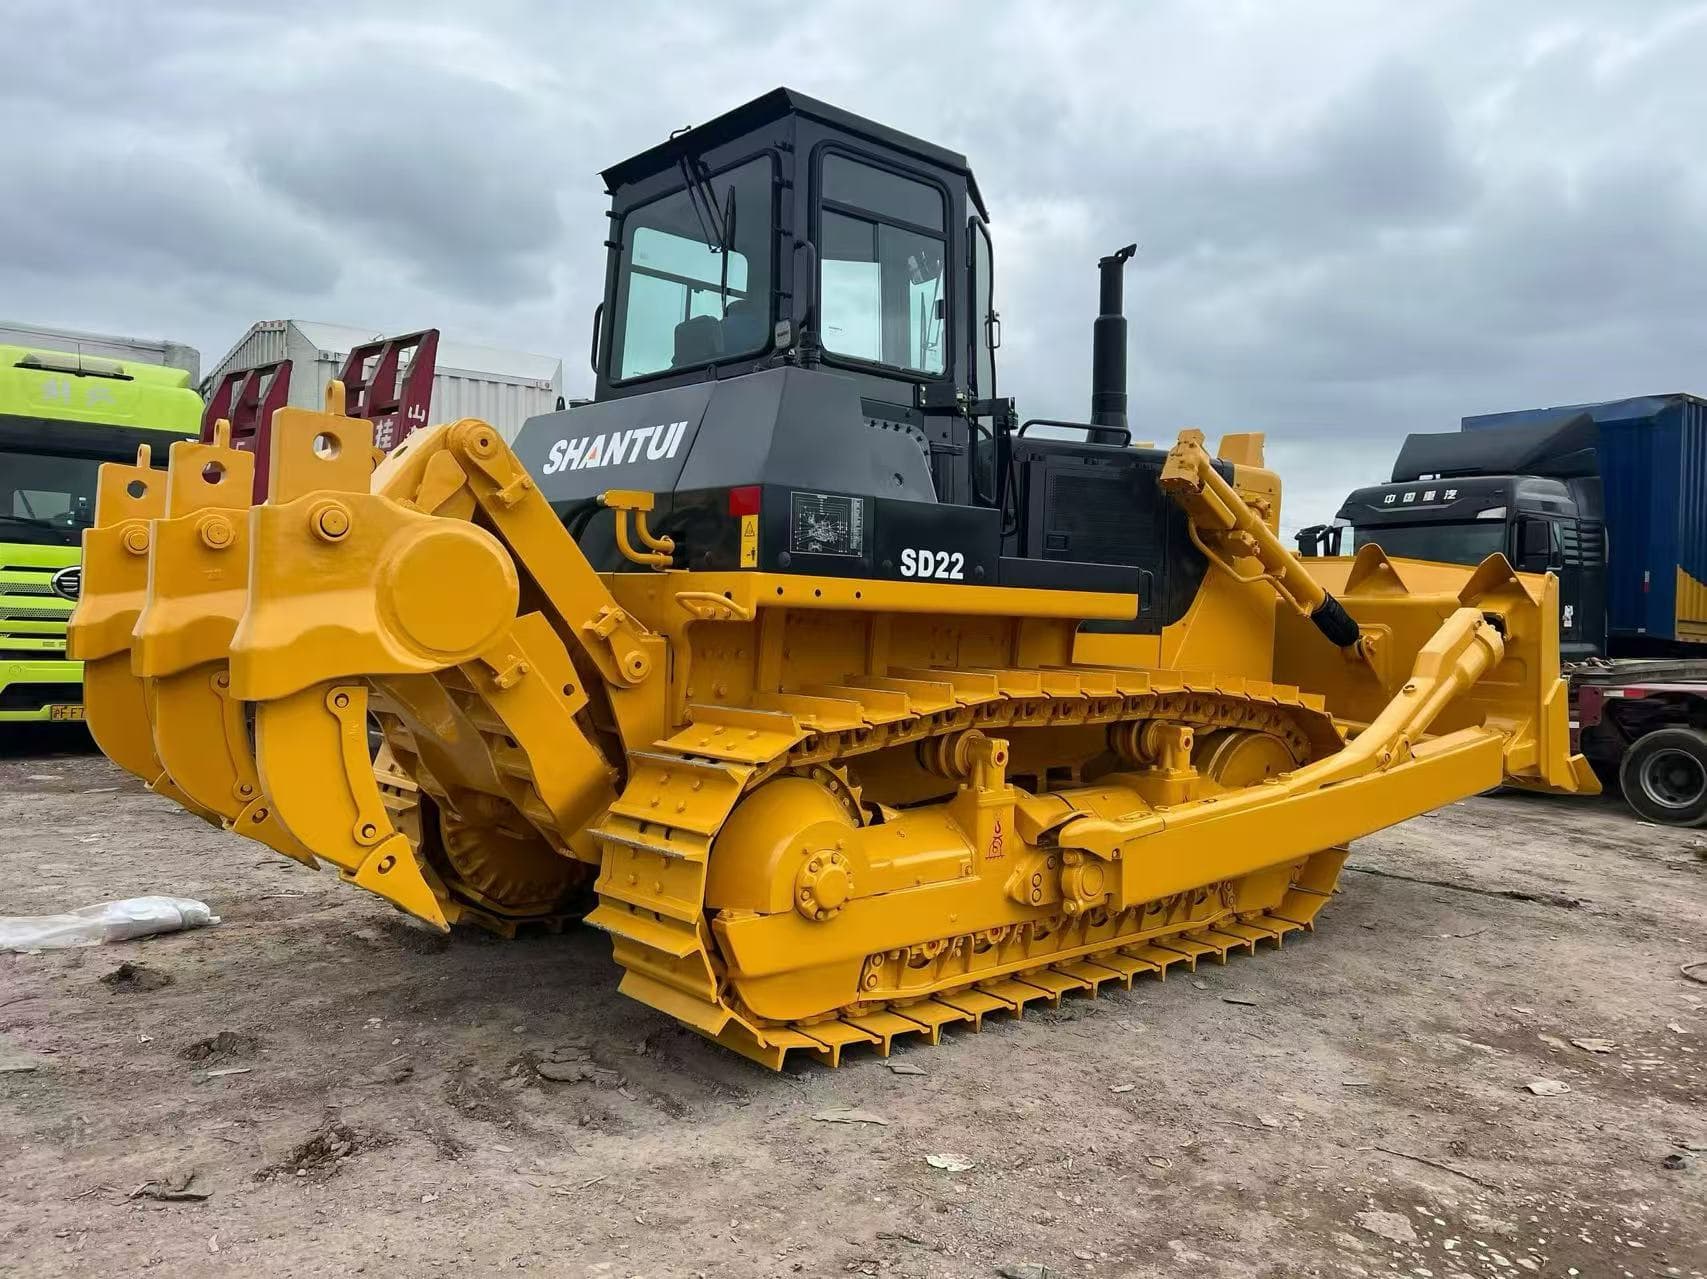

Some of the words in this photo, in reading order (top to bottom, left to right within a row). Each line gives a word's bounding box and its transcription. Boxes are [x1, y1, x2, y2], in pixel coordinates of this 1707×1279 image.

[542, 421, 688, 475] SHANTUI
[1384, 489, 1458, 504] 中国重汽
[900, 548, 964, 580] SD22
